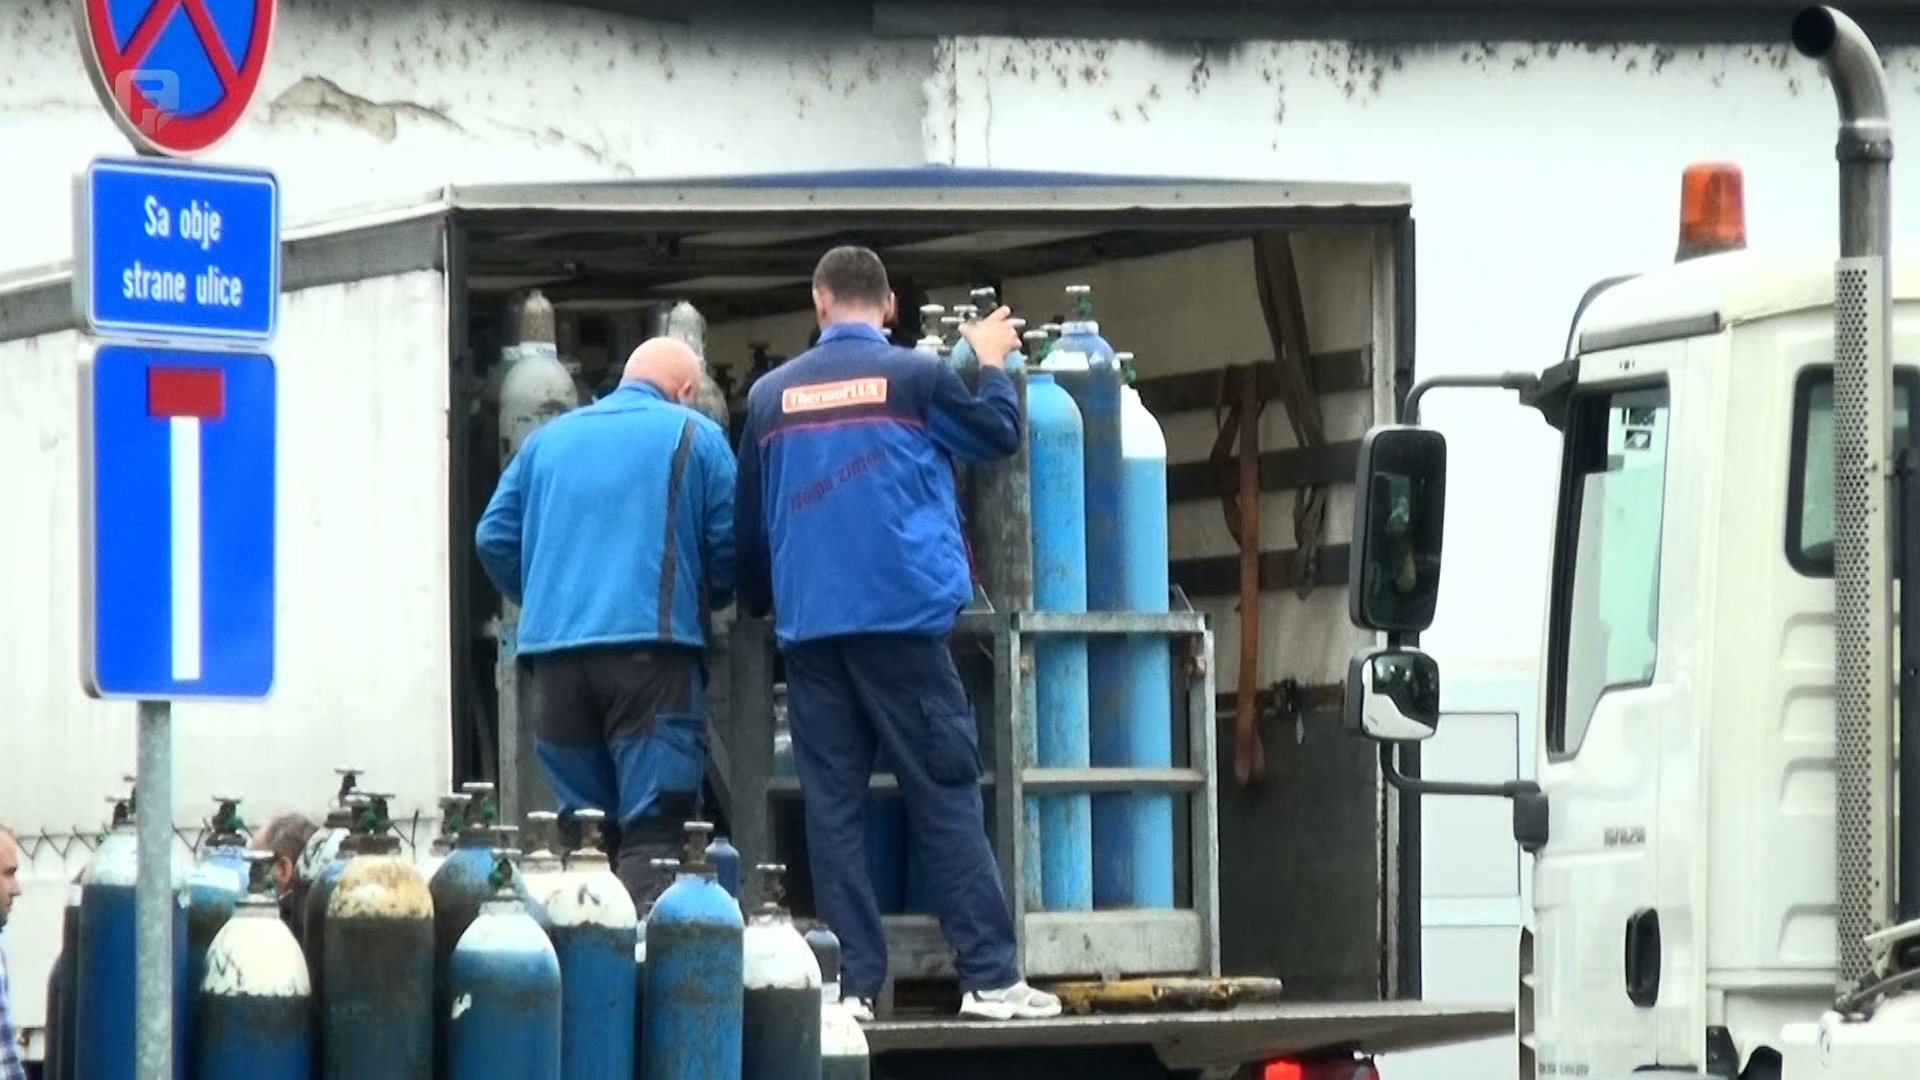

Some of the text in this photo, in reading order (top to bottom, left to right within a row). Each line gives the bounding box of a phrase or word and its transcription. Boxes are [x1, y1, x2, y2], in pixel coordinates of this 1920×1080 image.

[144, 195, 221, 250] Sa obje
[122, 260, 242, 307] strane ulice
